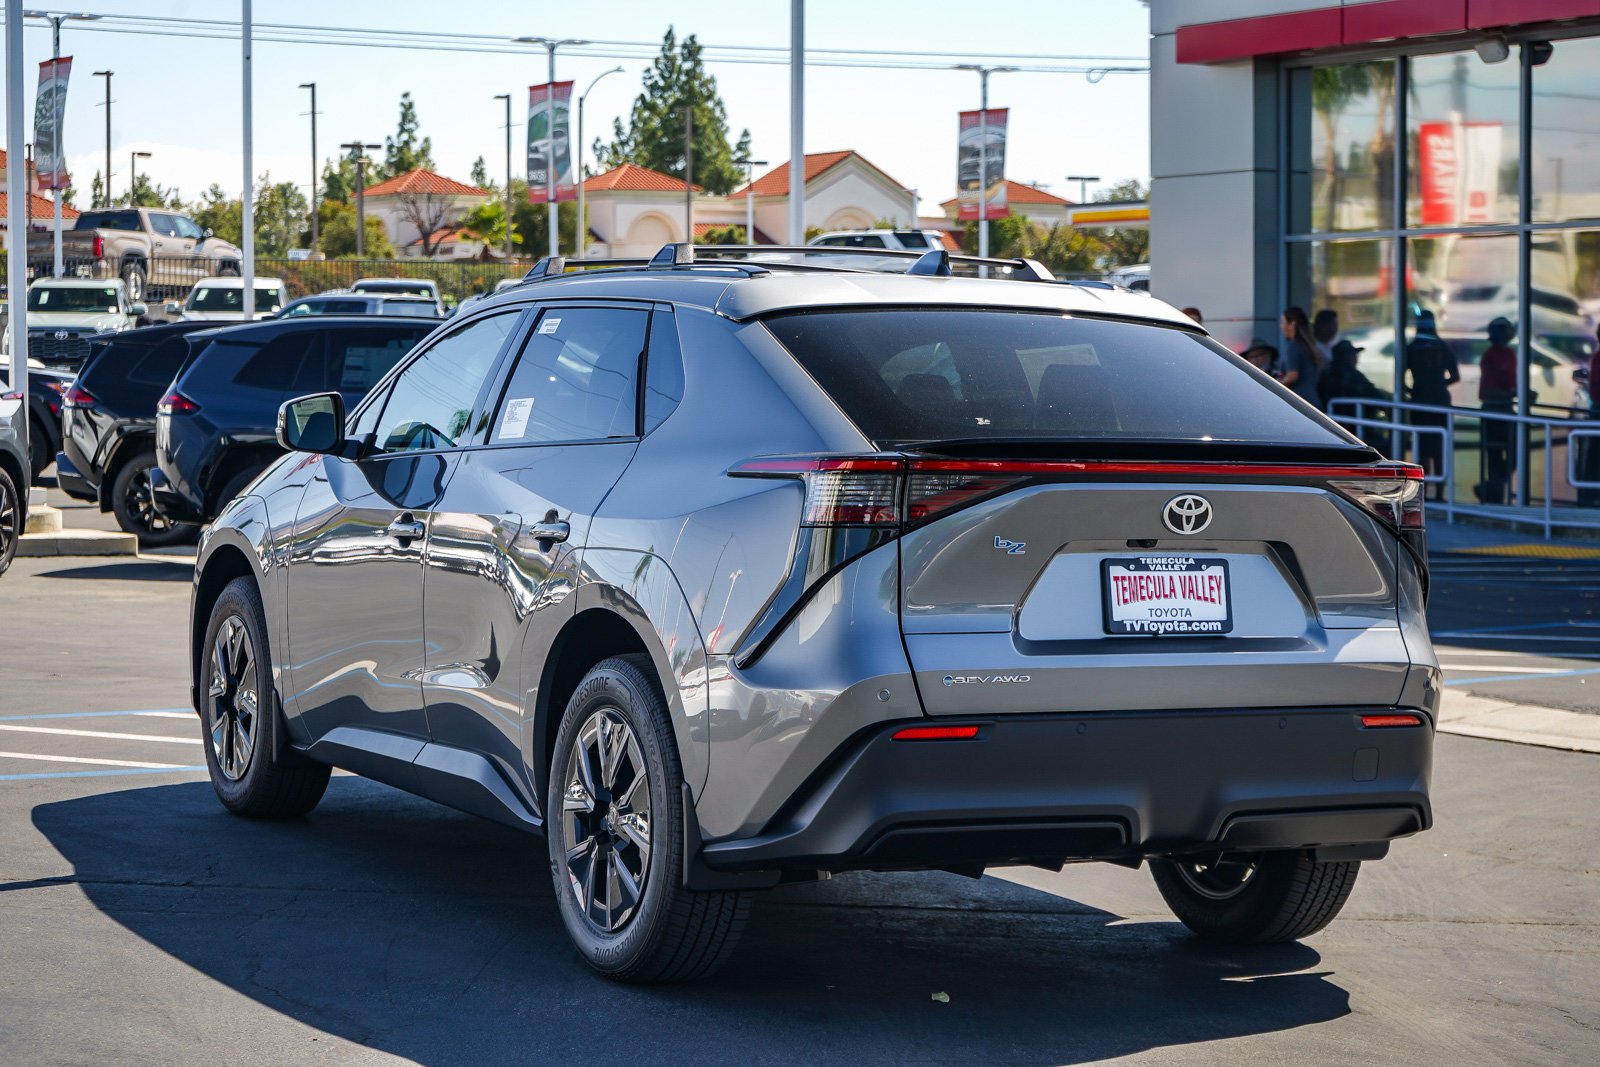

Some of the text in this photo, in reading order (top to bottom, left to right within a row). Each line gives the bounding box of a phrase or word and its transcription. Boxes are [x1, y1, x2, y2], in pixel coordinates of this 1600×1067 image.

[1139, 557, 1195, 565] TEMECULA
[1112, 575, 1222, 606] TEMECULA VALLEY
[1147, 607, 1192, 618] TOYOTA
[1123, 620, 1221, 634] TVToyota.com
[953, 675, 1031, 684] BEV AWD
[559, 677, 610, 743] BRIDGESTONE
